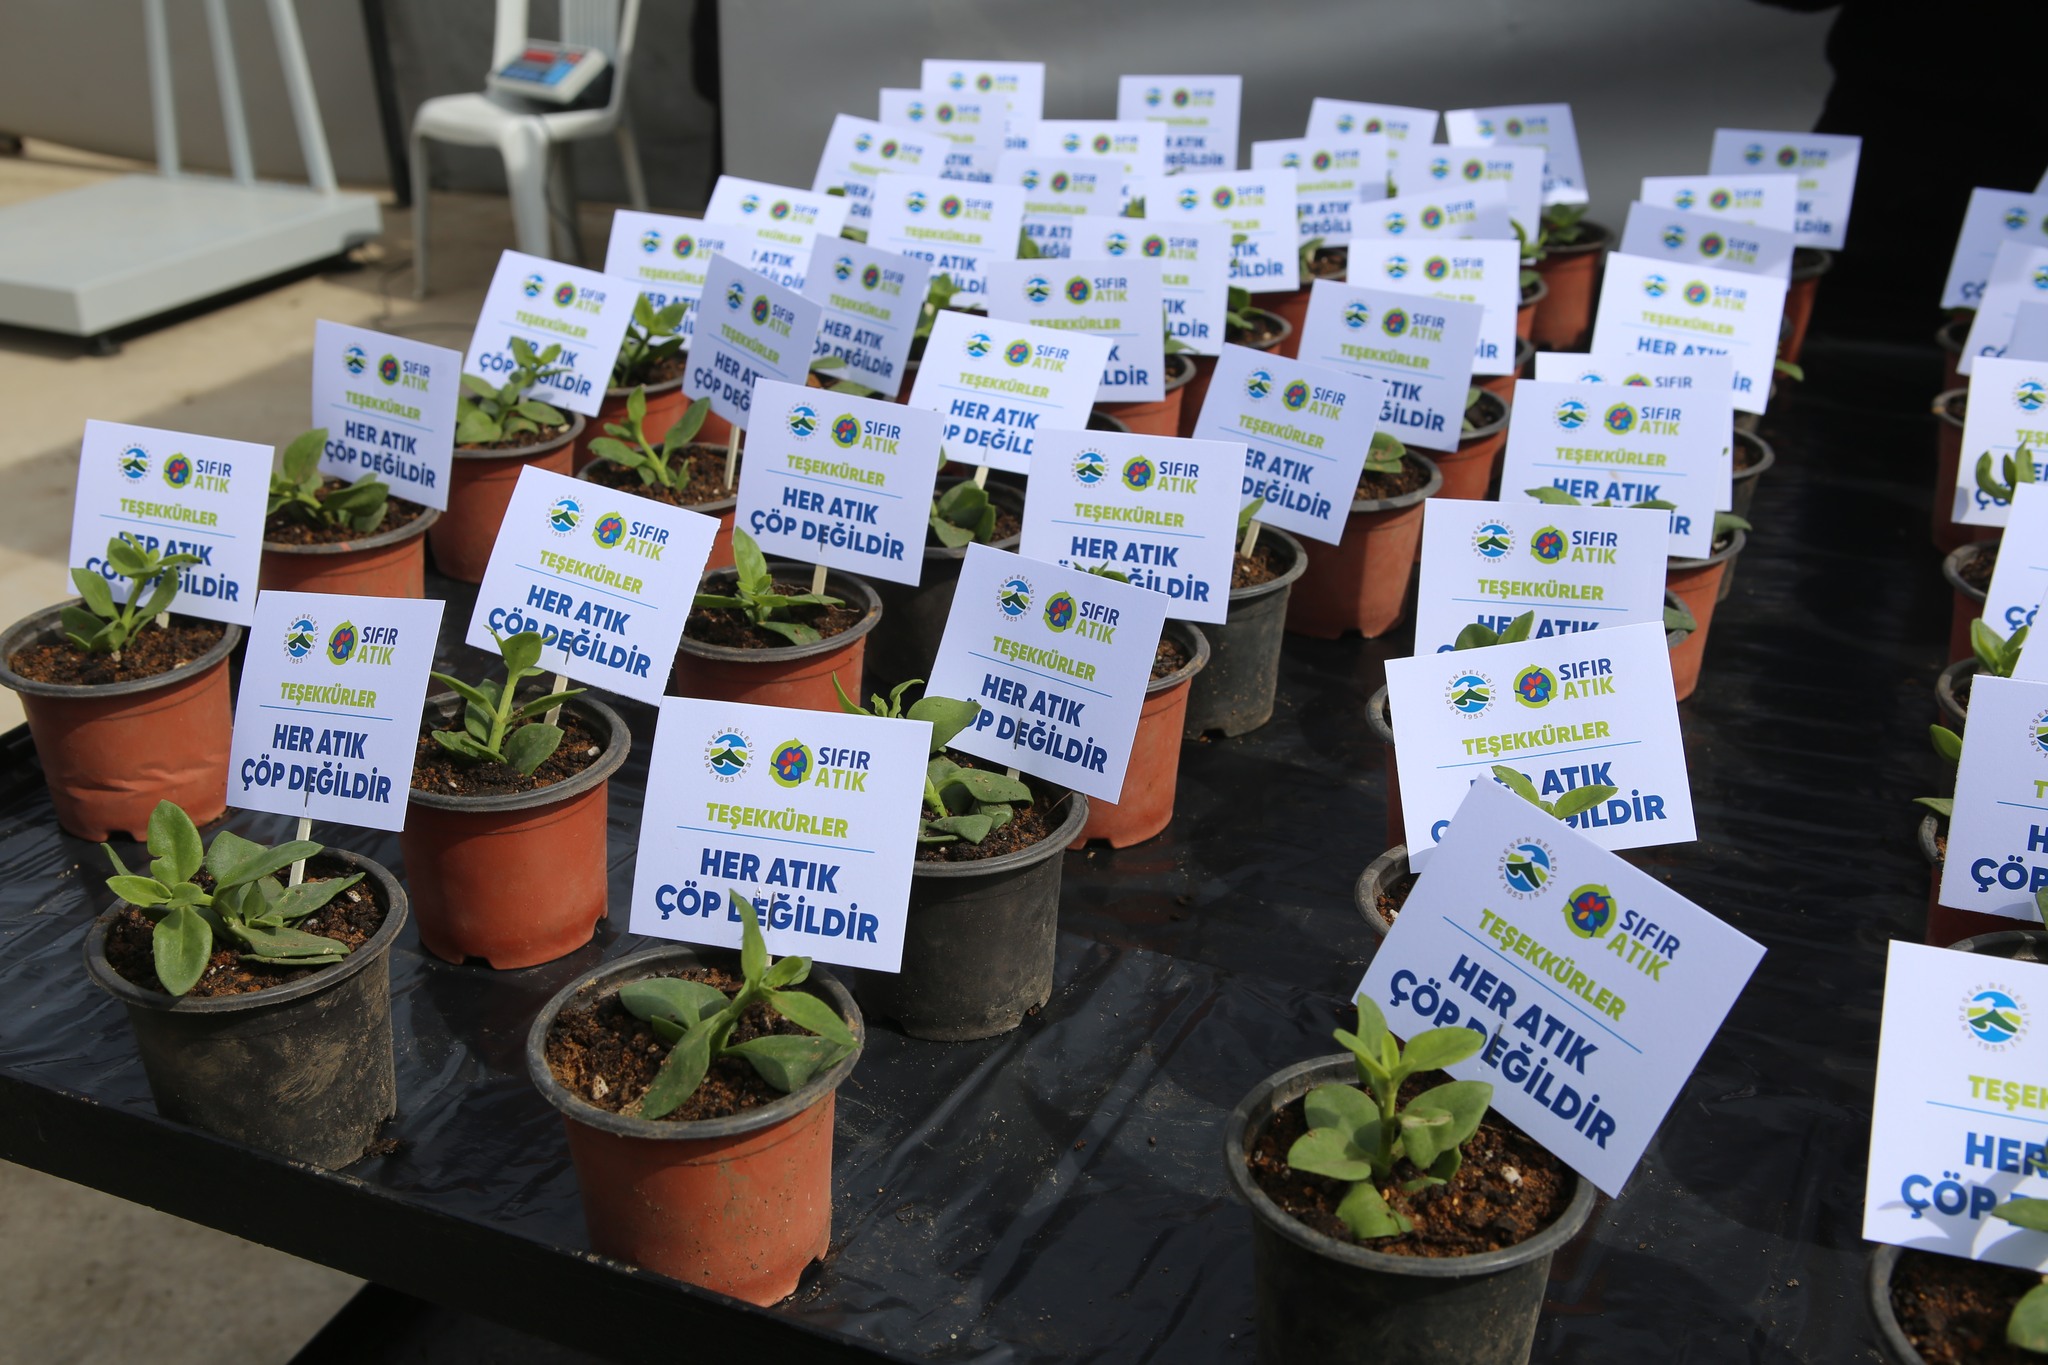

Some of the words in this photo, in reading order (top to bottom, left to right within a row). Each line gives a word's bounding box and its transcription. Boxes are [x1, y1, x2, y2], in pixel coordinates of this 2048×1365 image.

[1237, 185, 1265, 197] SIFIR
[793, 203, 819, 215] SIFIR
[966, 198, 994, 210] SIFIR
[1445, 200, 1476, 213] SIFIR
[963, 209, 992, 222] ATIK
[697, 237, 726, 250] SIFIR
[1168, 237, 1198, 249] SIFIR
[1728, 237, 1759, 252] SIFIR
[939, 254, 977, 271] ATIK
[1168, 248, 1198, 261] ATIK
[1452, 257, 1484, 269] SIFIR
[1725, 250, 1757, 265] ATIK
[882, 268, 905, 284] SIFIR
[1094, 277, 1128, 290] SIFIR
[1451, 268, 1483, 280] ATIK
[578, 287, 607, 304] SIFIR
[880, 280, 903, 296] ATIK
[1094, 289, 1128, 303] ATIK
[1714, 285, 1748, 300] SIFIR
[574, 300, 603, 316] ATIK
[772, 304, 795, 324] SIFIR
[830, 295, 891, 320] TEŞEKKÜRLER
[1712, 299, 1745, 312] ATIK
[516, 310, 588, 339] TEŞEKKÜRLER
[769, 316, 792, 337] ATIK
[1412, 312, 1445, 329] SIFIR
[1642, 311, 1734, 335] TEŞEKKÜRLER
[721, 324, 780, 363] TEŞEKKÜRLER
[824, 319, 851, 340] HER
[855, 329, 884, 350] ATIK
[1409, 326, 1443, 342] ATIK
[1035, 344, 1070, 361] SIFIR
[1341, 344, 1429, 369] TEŞEKKÜRLER
[1638, 337, 1676, 355] HER
[404, 360, 429, 377] SIFIR
[479, 352, 513, 373] ÇÖP
[715, 352, 739, 378] HER
[834, 348, 894, 379] DEĞİLDİR
[1032, 358, 1065, 374] ATIK
[402, 375, 428, 391] ATIK
[695, 368, 721, 393] ÇÖP
[960, 372, 1050, 398] TEŞEKKÜRLER
[1655, 375, 1693, 389] SIFIR
[346, 391, 421, 420] TEŞEKKÜRLER
[1313, 387, 1345, 406] SIFIR
[951, 399, 989, 421] HER
[993, 408, 1040, 430] ATIK
[1309, 403, 1343, 420] ATIK
[1641, 405, 1682, 422] SIFIR
[345, 420, 375, 446] HER
[381, 430, 417, 455] ATIK
[865, 419, 901, 439] SIFIR
[1240, 414, 1324, 448] TEŞEKKÜRLER
[1639, 420, 1680, 436] ATIK
[862, 437, 900, 455] ATIK
[1557, 447, 1666, 466] TEŞEKKÜRLER
[196, 459, 231, 478] SIFIR
[325, 438, 356, 464] ÇÖP
[362, 453, 435, 488] DEĞİLDİR
[787, 454, 885, 486] TEŞEKKÜRLER
[1160, 461, 1199, 478] SIFIR
[1268, 457, 1314, 485] ATIK
[194, 475, 229, 493] ATIK
[1158, 476, 1197, 493] ATIK
[1554, 478, 1603, 499] HER
[1605, 482, 1660, 501] ATIK
[783, 486, 824, 513] HER
[829, 497, 879, 525] ATIK
[1242, 478, 1331, 520] DEĞİLDİR
[120, 498, 217, 526] TEŞEKKÜRLER
[1075, 502, 1184, 527] TEŞEKKÜRLER
[630, 522, 670, 544] SIFIR
[751, 508, 797, 535] ÇÖP
[802, 521, 904, 562] DEĞİLDİR
[1572, 530, 1617, 546] SIFIR
[624, 537, 665, 561] ATIK
[1071, 536, 1117, 560] HER
[1124, 542, 1179, 567] ATIK
[1571, 547, 1616, 564] ATIK
[540, 550, 644, 594] TEŞEKKÜRLER
[1478, 579, 1603, 600] TEŞEKKÜRLER
[526, 584, 573, 617] HER
[575, 600, 631, 636] ATIK
[1080, 601, 1120, 626] SIFIR
[362, 626, 398, 645] SIFIR
[1075, 620, 1116, 644] ATIK
[357, 645, 394, 666] ATIK
[542, 625, 652, 679] DEĞİLDİR
[994, 635, 1096, 681] TEŞEKKÜRLER
[1559, 658, 1612, 680] SIFIR
[281, 682, 376, 708] TEŞEKKÜRLER
[1563, 676, 1615, 699] ATIK
[982, 674, 1027, 709] HER
[1029, 691, 1085, 727] ATIK
[1462, 711, 1484, 720] 1953
[273, 724, 313, 753] HER
[316, 729, 368, 759] ATIK
[997, 717, 1107, 774] DEĞİLDİR
[1462, 720, 1610, 757] TEŞEKKÜRLER
[704, 729, 723, 775] ARDEŞEN
[818, 746, 870, 770] SIFIR
[242, 754, 285, 791] ÇÖP
[289, 762, 392, 803] DEĞİLDİR
[714, 774, 735, 784] 1953
[815, 767, 868, 792] ATIK
[1542, 762, 1615, 795] ATIK
[706, 802, 848, 838] TEŞEKKÜRLER
[1499, 837, 1531, 880] ARDEŞEN
[700, 848, 760, 882] HER
[765, 858, 840, 893] ATIK
[1503, 883, 1523, 900] 1953
[655, 880, 720, 920] ÇÖP
[728, 892, 879, 943] DEĞİLDİR
[1620, 909, 1681, 959] SIFIR
[1478, 908, 1627, 1022] TEŞEKKÜRLER
[1607, 933, 1670, 982] ATIK
[1390, 969, 1460, 1028] ÇÖP
[1449, 954, 1517, 1019] HER
[1514, 1004, 1599, 1076] ATIK
[1902, 1170, 1997, 1219] ÇÖP
